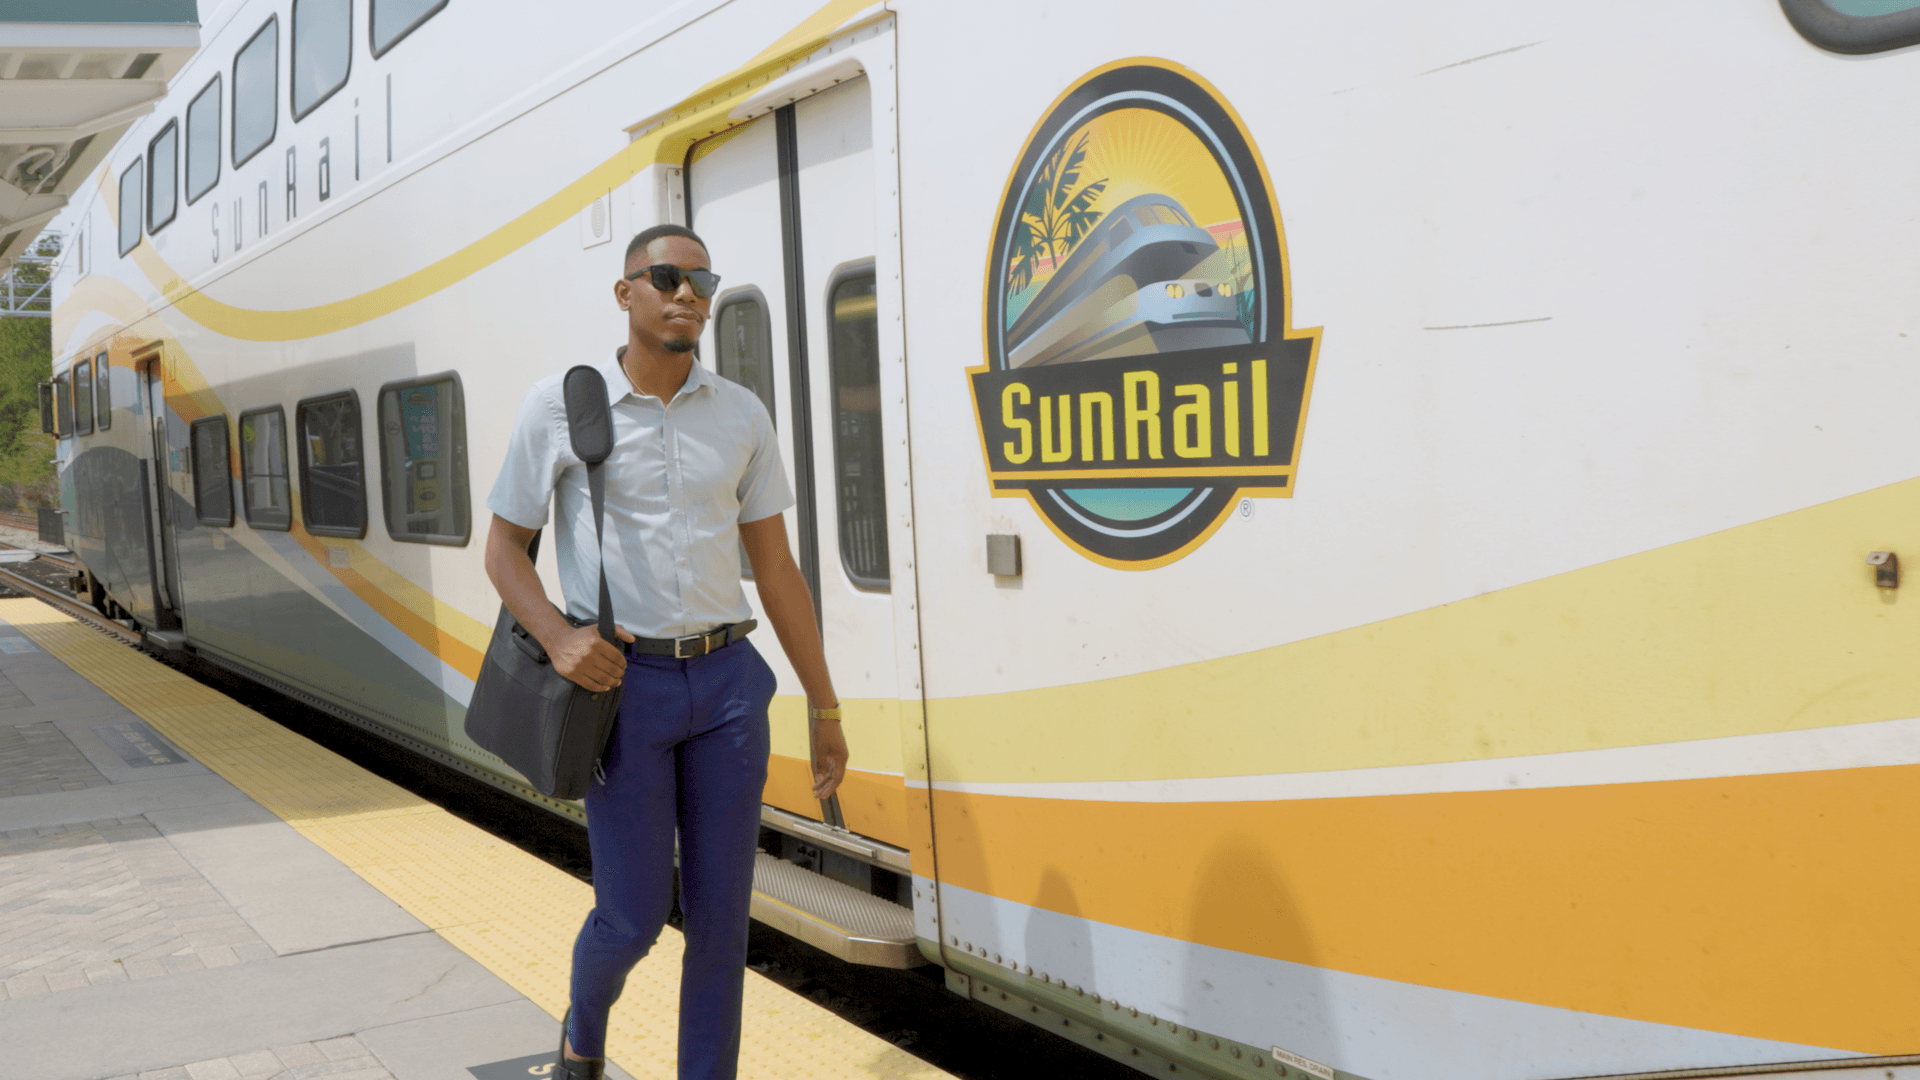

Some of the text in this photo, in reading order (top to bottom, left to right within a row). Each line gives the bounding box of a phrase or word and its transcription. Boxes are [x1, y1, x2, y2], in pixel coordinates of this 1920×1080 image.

[212, 74, 392, 263] SunRail
[1001, 360, 1269, 464] SunRail
[1276, 1050, 1330, 1077] MAIN RES. DRAIN
